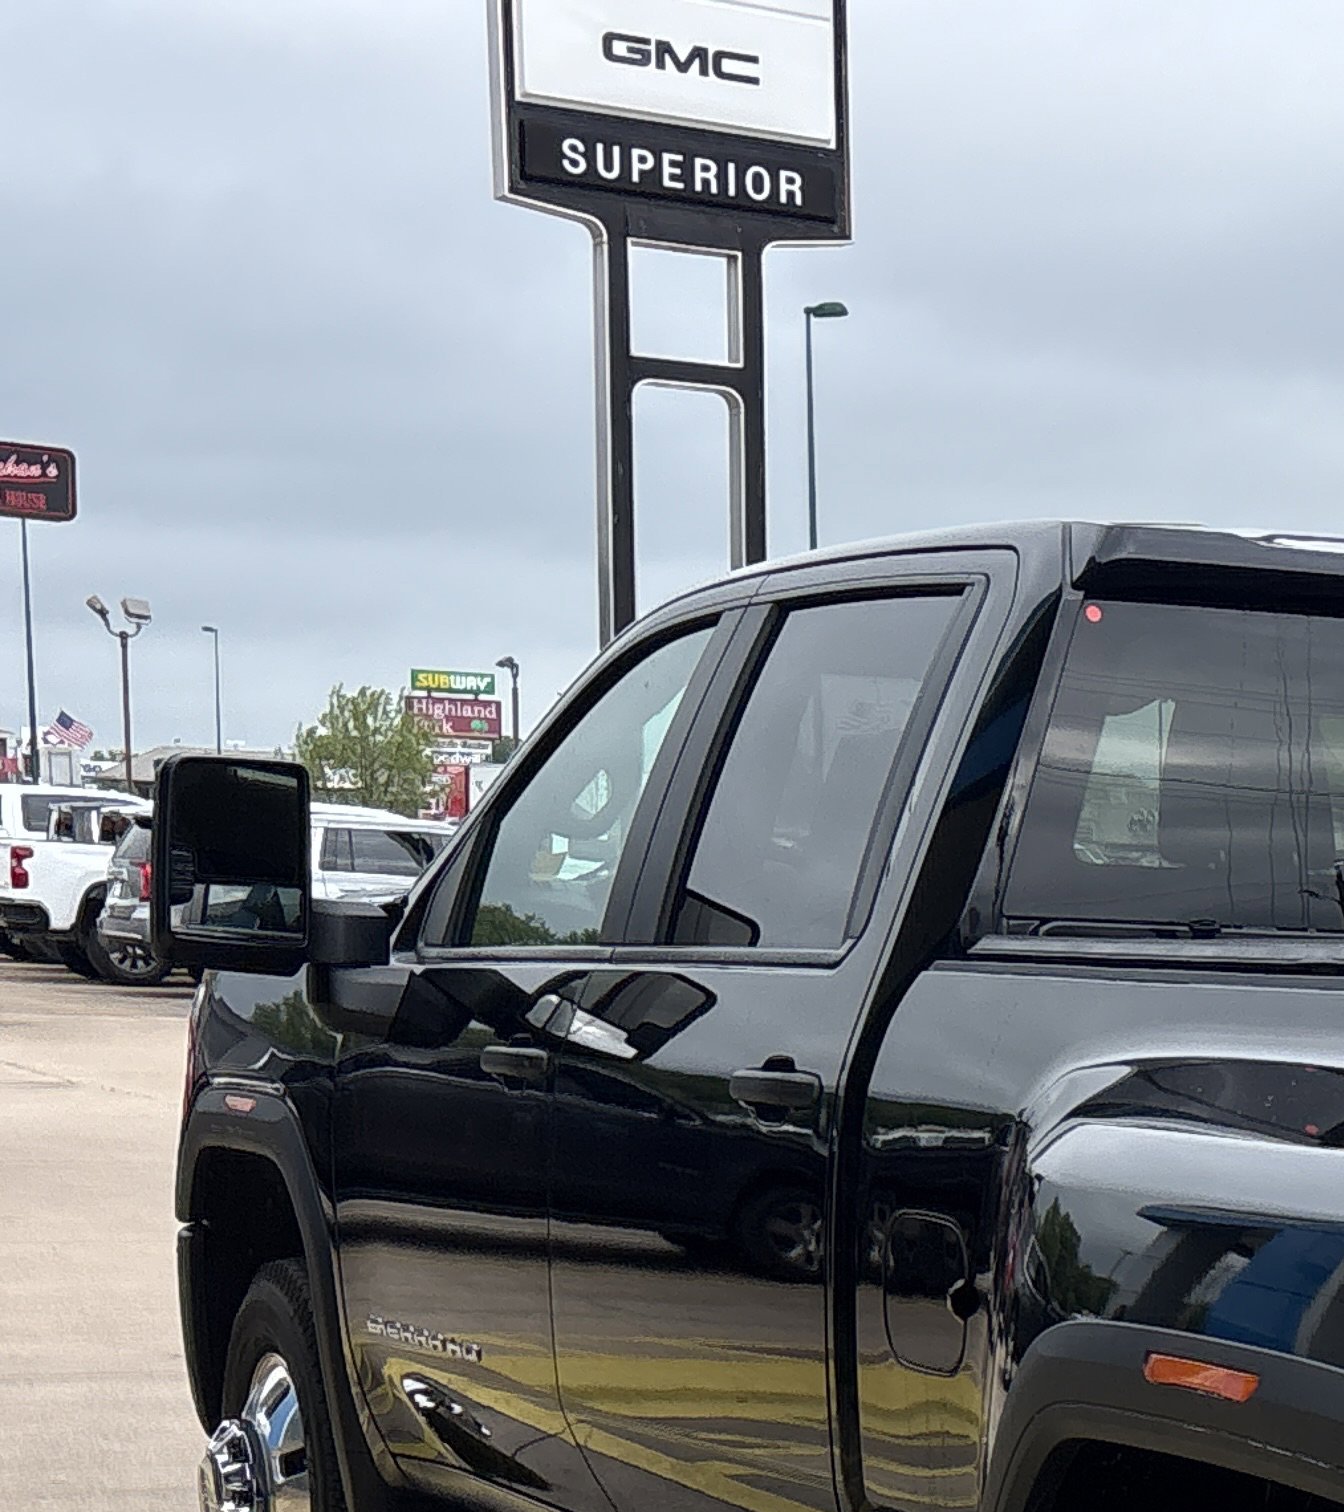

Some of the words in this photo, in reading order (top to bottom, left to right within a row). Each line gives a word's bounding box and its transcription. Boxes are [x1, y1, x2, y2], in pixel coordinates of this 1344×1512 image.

[602, 31, 760, 86] GMC
[561, 137, 803, 206] SUPERIOR
[416, 673, 492, 691] SUBWAY
[413, 699, 497, 719] Highland
